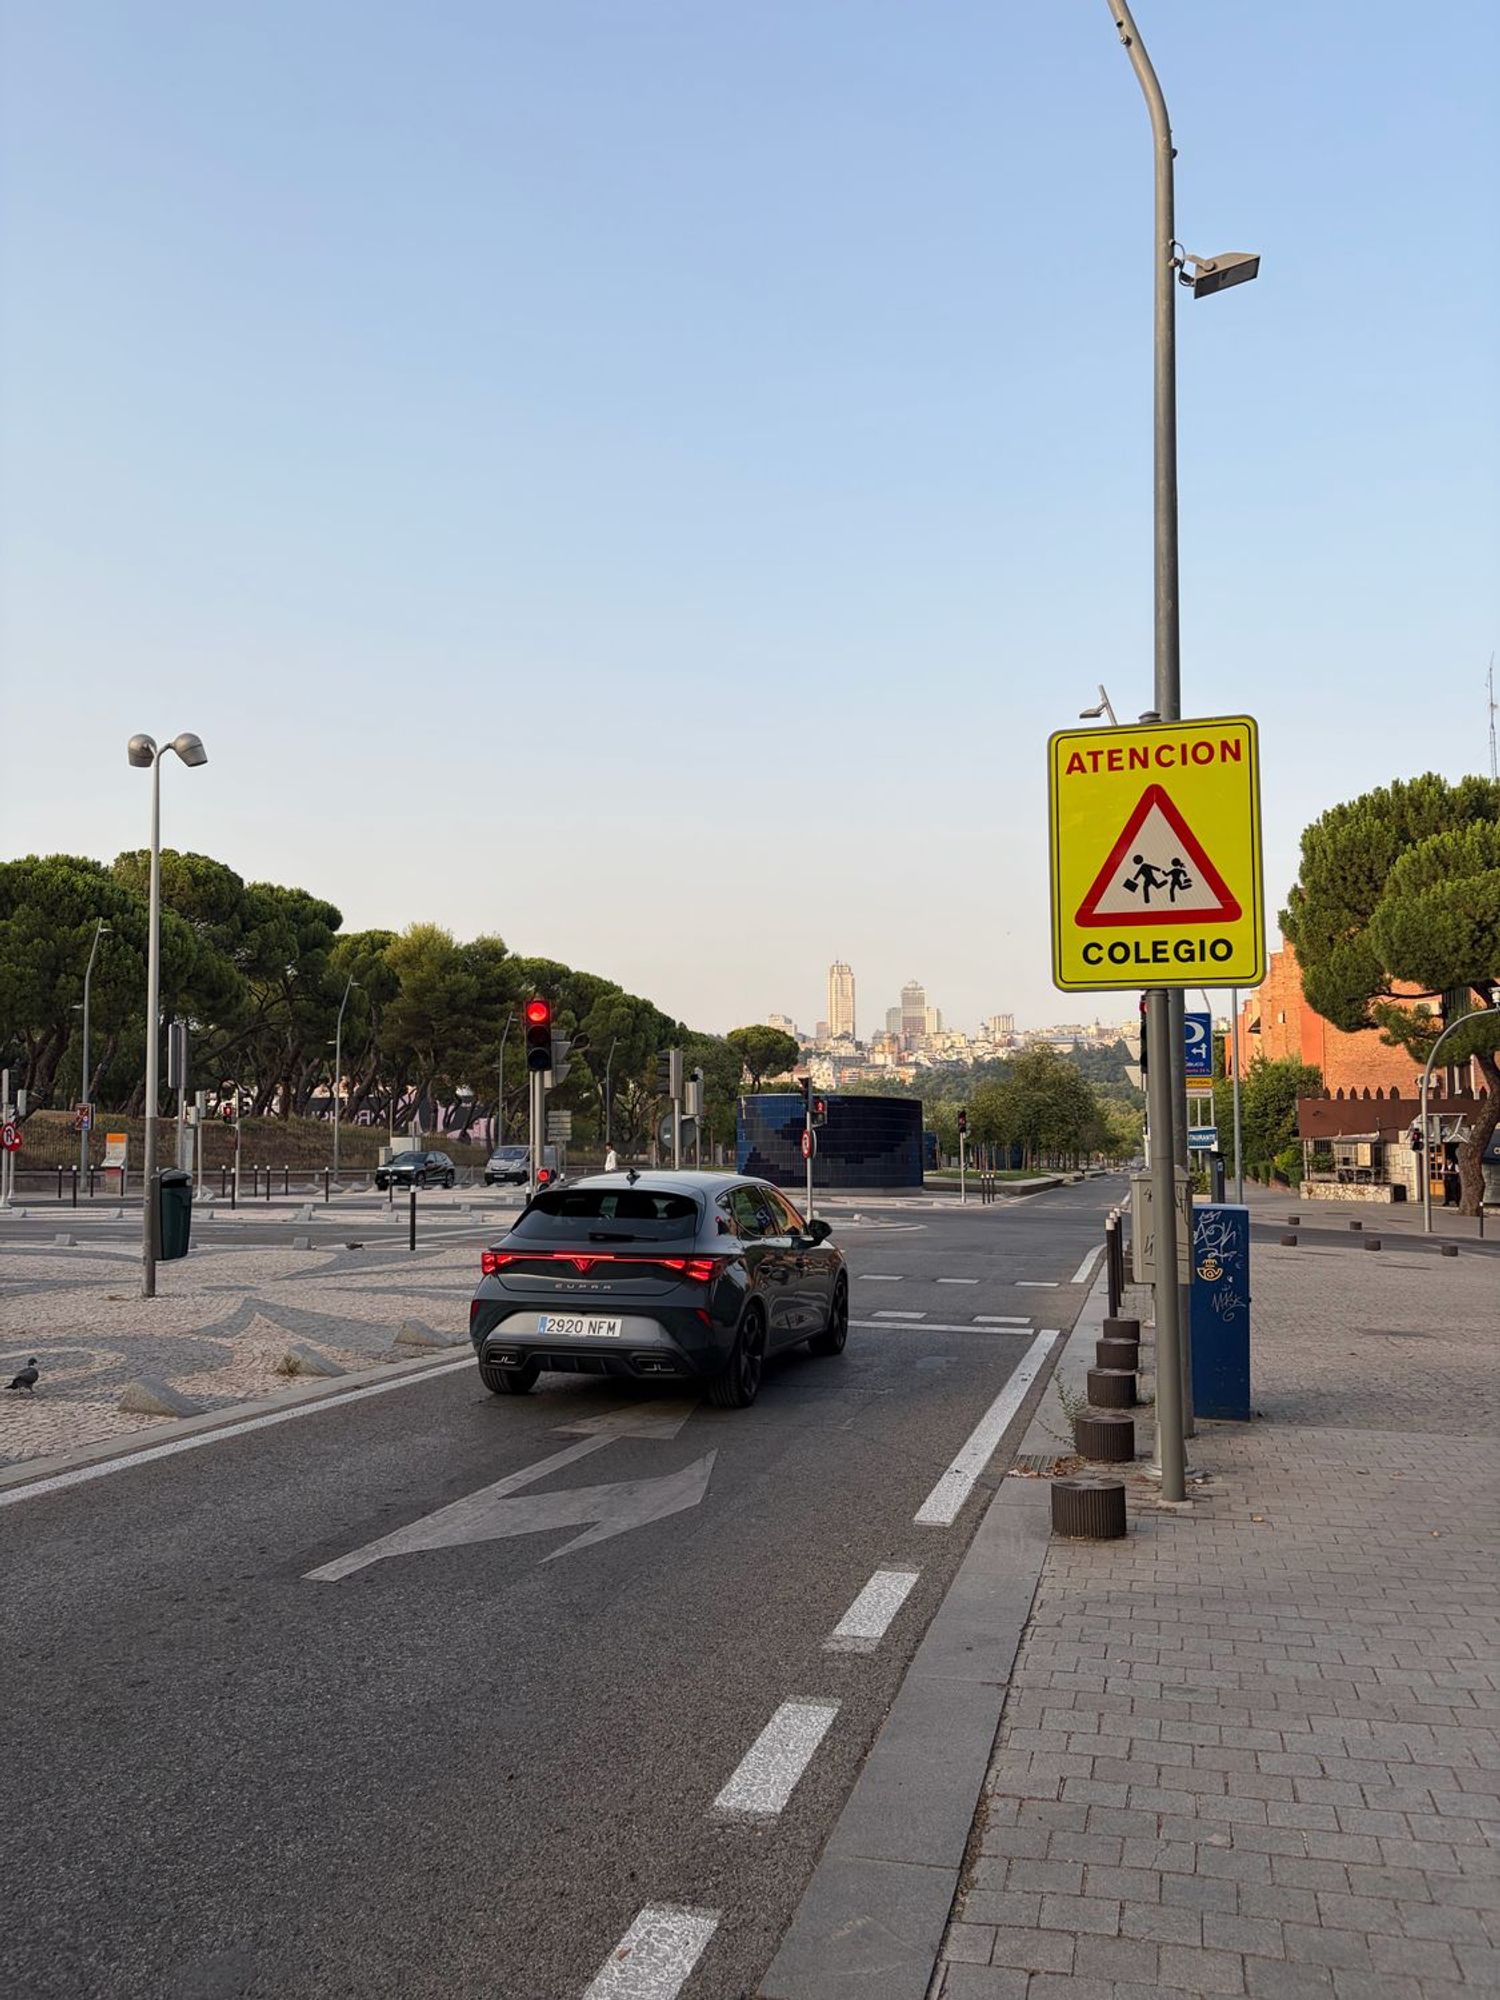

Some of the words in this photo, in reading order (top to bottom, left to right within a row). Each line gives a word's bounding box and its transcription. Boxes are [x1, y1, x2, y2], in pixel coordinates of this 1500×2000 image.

[1065, 739, 1242, 775] ATENCION
[1082, 938, 1233, 965] COLEGIO
[546, 1318, 584, 1334] 2920
[587, 1320, 617, 1336] NFM
